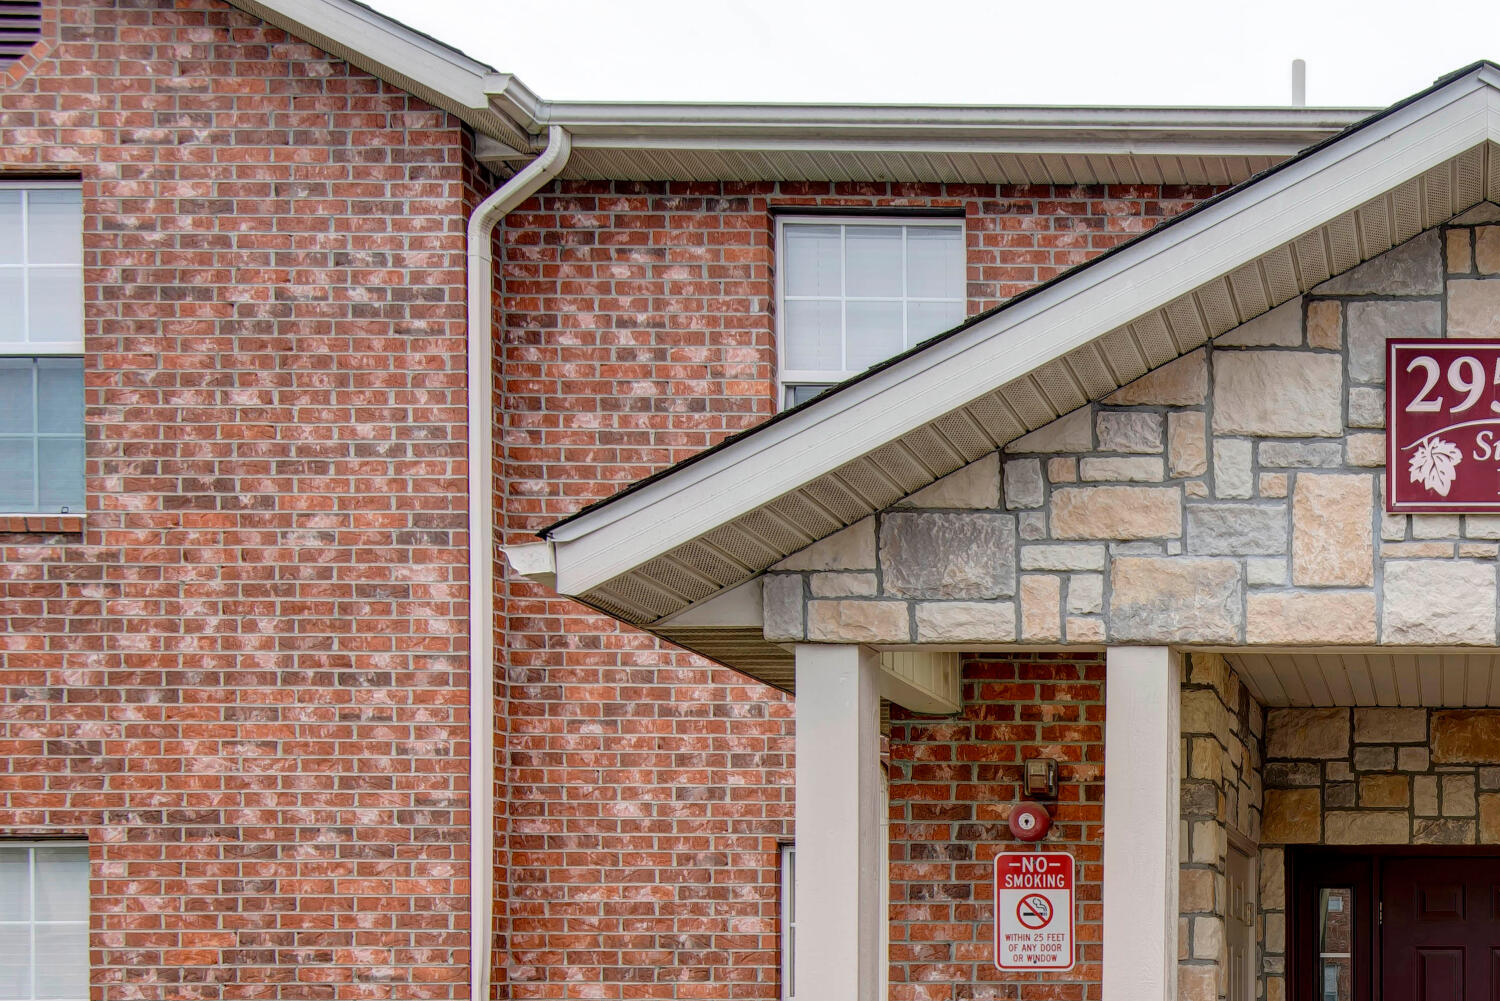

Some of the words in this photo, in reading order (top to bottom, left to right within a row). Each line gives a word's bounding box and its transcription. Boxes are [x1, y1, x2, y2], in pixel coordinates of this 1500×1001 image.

[1021, 856, 1048, 873] NO
[1004, 873, 1065, 888] SMOKING
[1005, 933, 1031, 942] WITHIN
[1033, 933, 1044, 942] 25
[1047, 933, 1065, 942] FEET
[1008, 943, 1018, 952] OF
[1021, 943, 1037, 952] ANY
[1040, 943, 1062, 952] DOOR
[1012, 953, 1024, 963] OR
[1026, 953, 1058, 963] WINDOW
